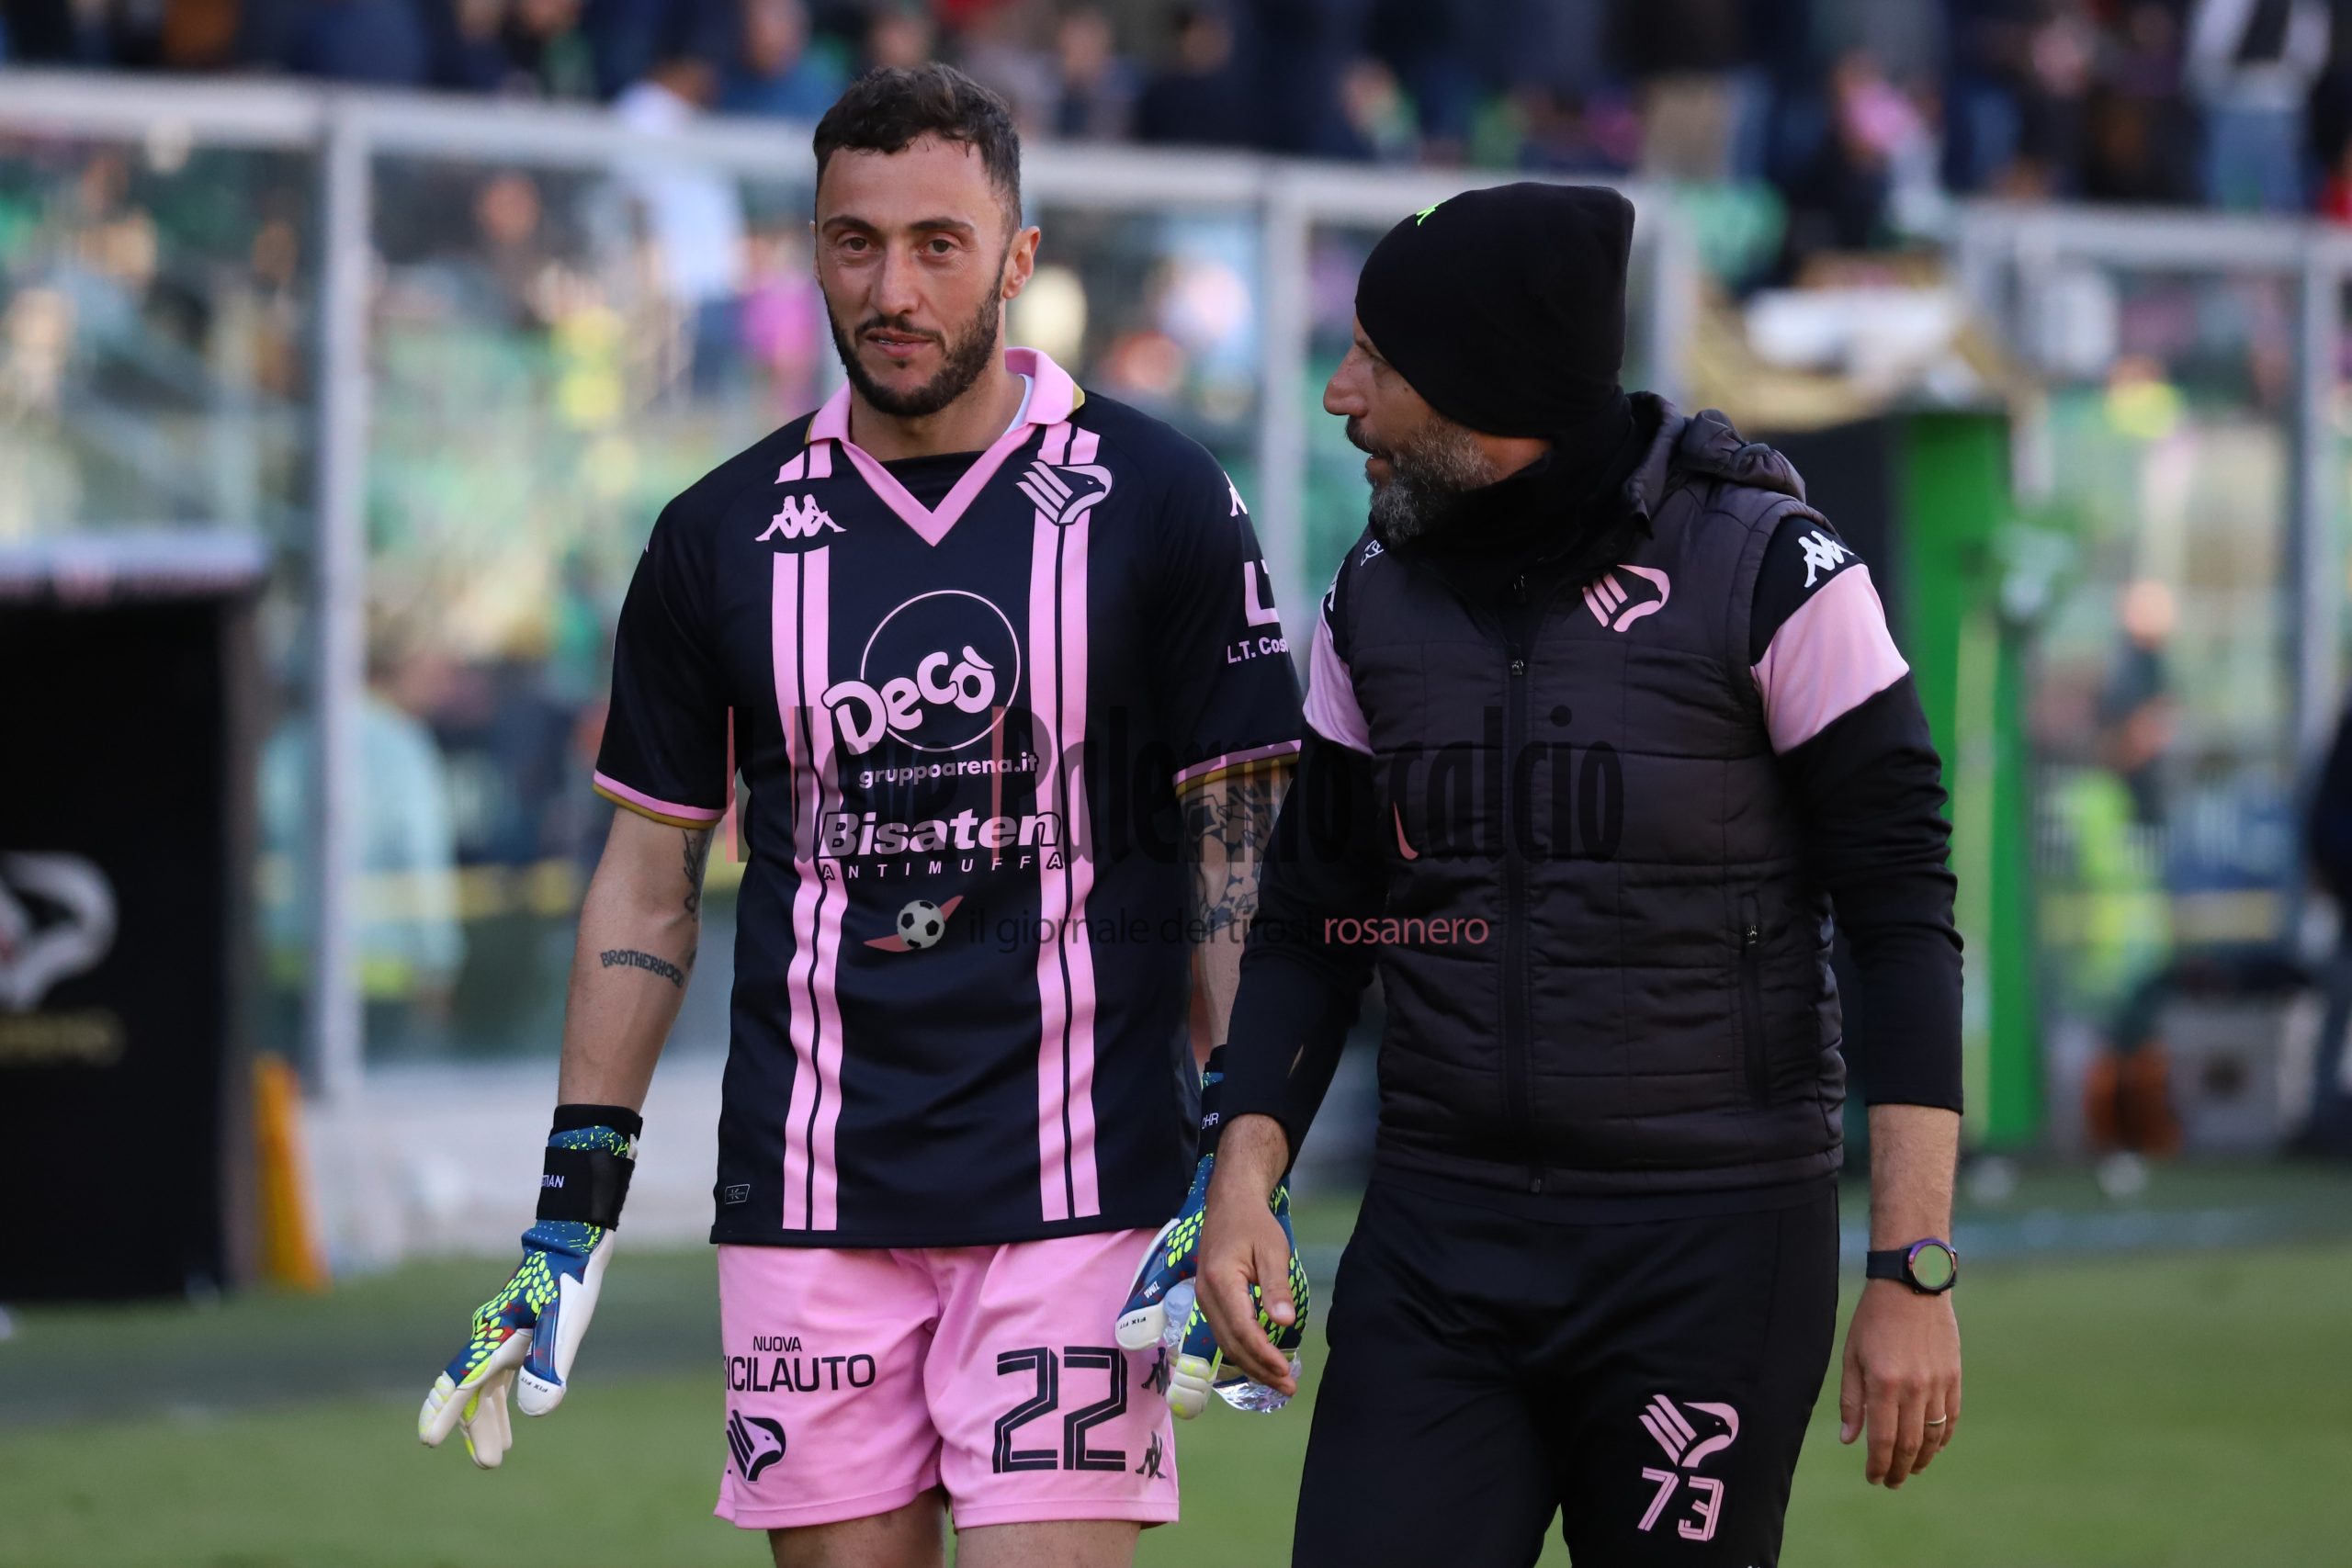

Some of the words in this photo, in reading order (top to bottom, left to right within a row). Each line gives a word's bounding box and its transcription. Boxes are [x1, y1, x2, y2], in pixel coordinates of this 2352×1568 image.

[1227, 640, 1257, 664] L.T.
[1258, 637, 1289, 656] Cos
[858, 750, 1039, 790] gruppoarena.it
[818, 807, 1062, 858] Bisaten
[822, 851, 1064, 881] ANTIMUFFA
[542, 1174, 565, 1189] TIAN
[752, 1336, 803, 1353] NUOVA
[991, 1346, 1128, 1474] 22
[1636, 1466, 1725, 1542] 73
